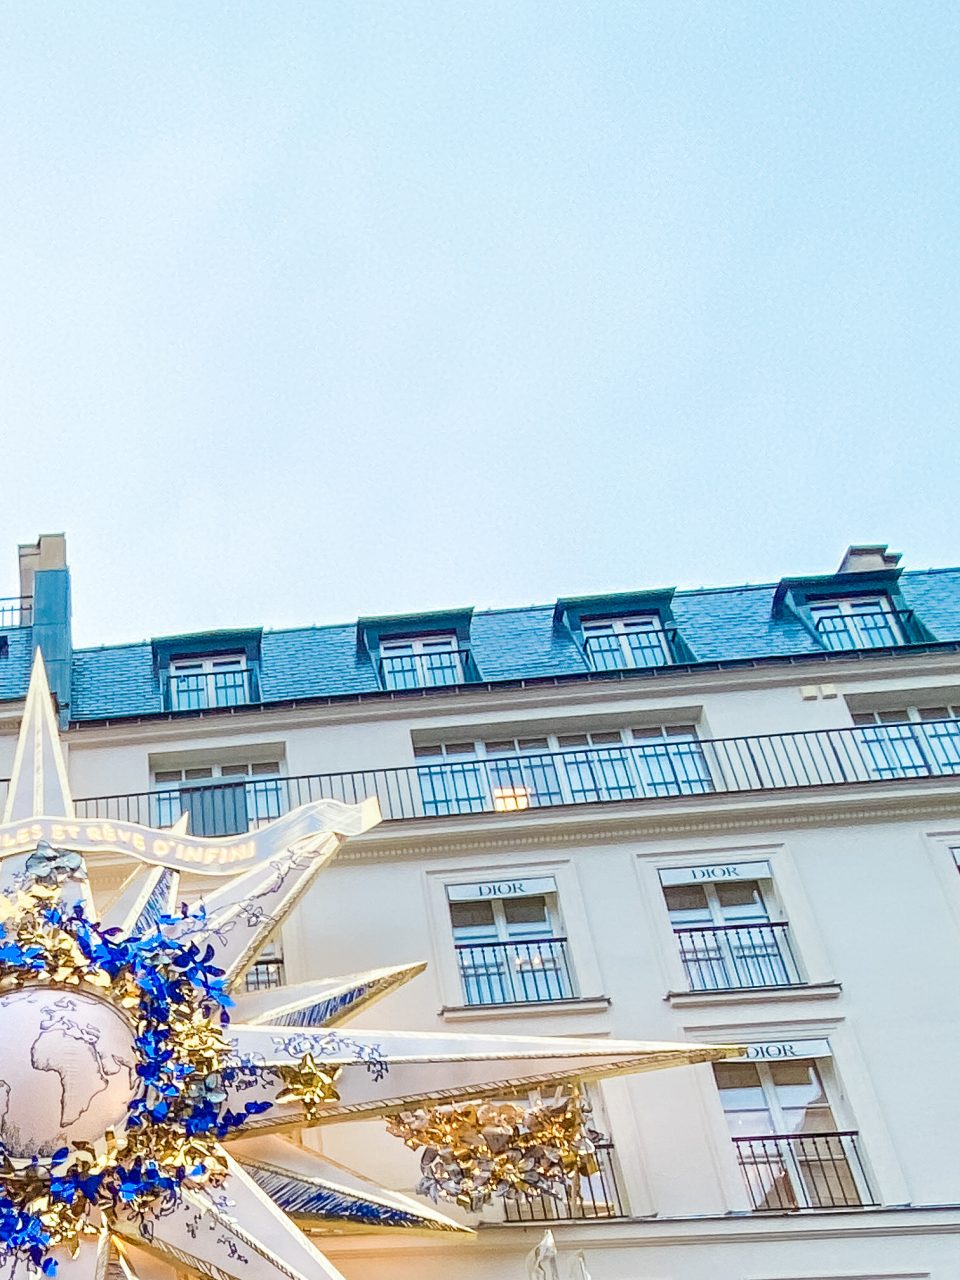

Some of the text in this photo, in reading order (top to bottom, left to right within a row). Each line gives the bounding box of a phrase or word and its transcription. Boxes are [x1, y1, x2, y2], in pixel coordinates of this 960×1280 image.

[51, 824, 81, 841] ET
[691, 866, 740, 880] DIOR
[478, 882, 526, 897] DIOR
[745, 1044, 797, 1059] DIOR
